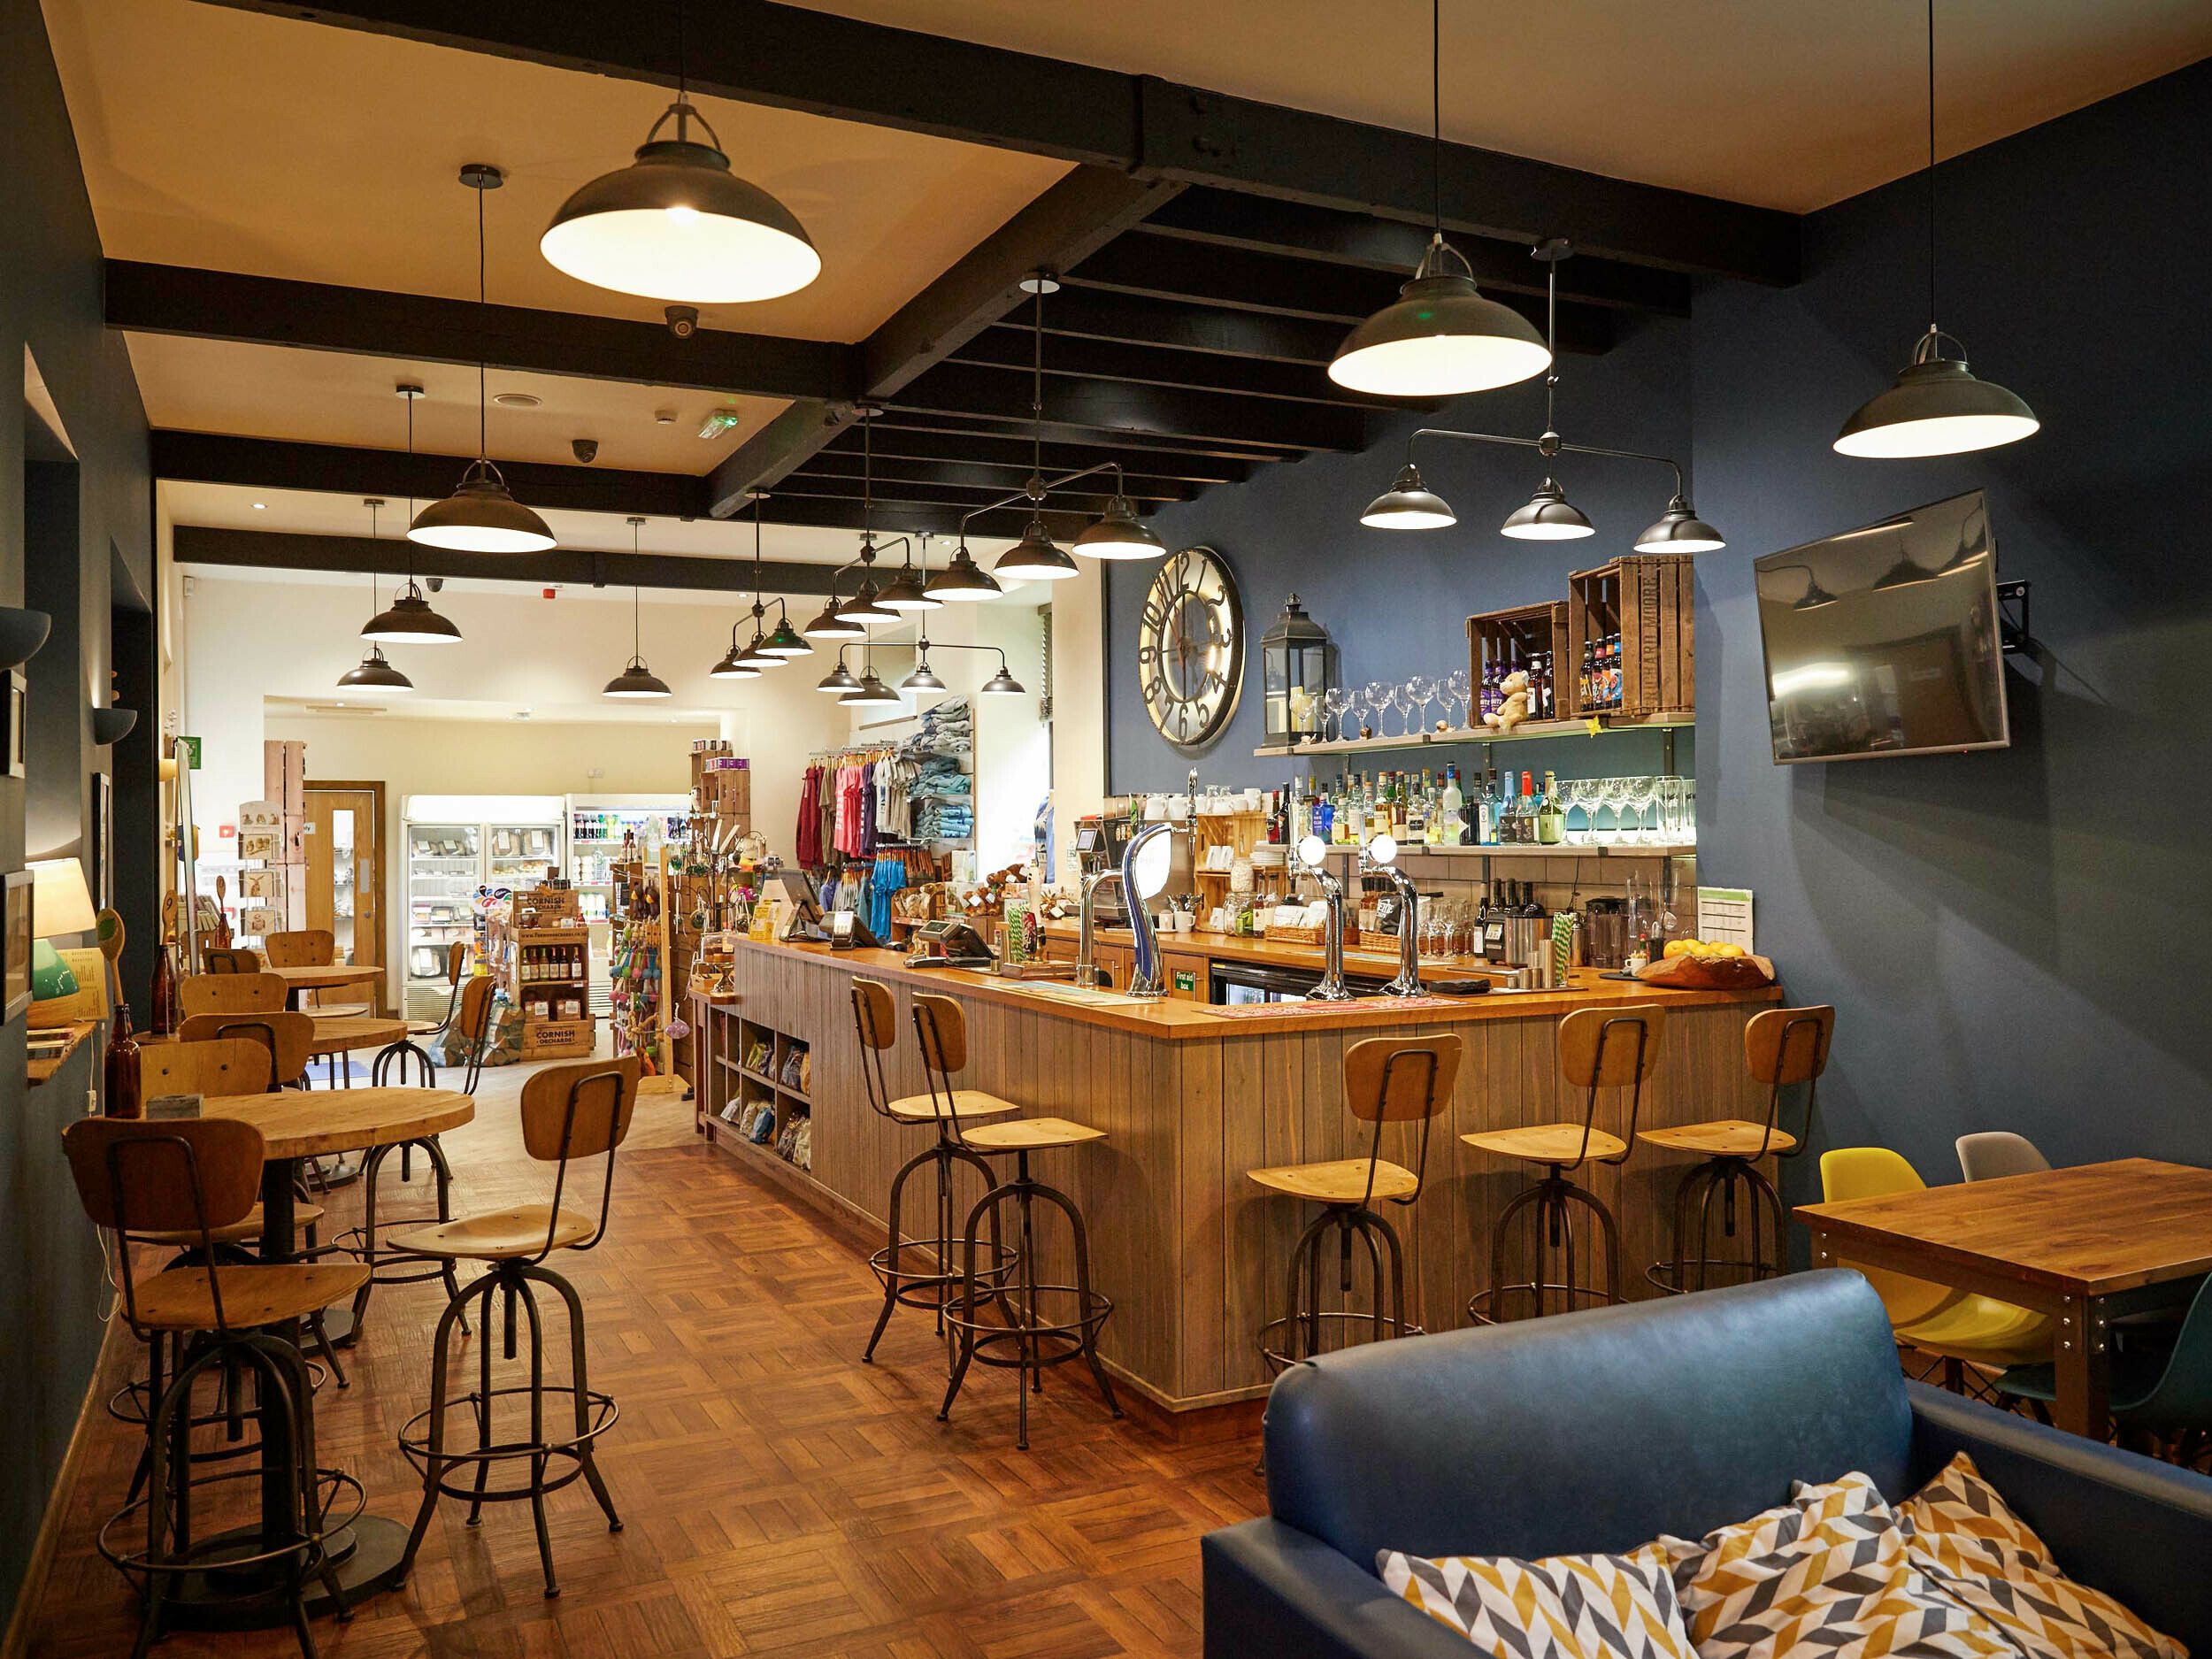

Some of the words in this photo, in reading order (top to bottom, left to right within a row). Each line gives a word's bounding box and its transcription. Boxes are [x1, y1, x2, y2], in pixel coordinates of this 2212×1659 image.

[1174, 552, 1191, 594] 12
[1196, 557, 1208, 594] 1
[1206, 584, 1228, 607] 2
[1642, 577, 1657, 628] MOORE
[1141, 601, 1163, 638] 10
[1139, 646, 1157, 664] 9
[1144, 675, 1162, 704] 8
[1211, 670, 1227, 695] 4
[1159, 697, 1175, 734] 7
[1178, 703, 1189, 741] 6
[1194, 698, 1210, 729] 5
[166, 898, 173, 910] 9
[1177, 972, 1187, 980] First
[536, 1030, 575, 1039] CORNISH
